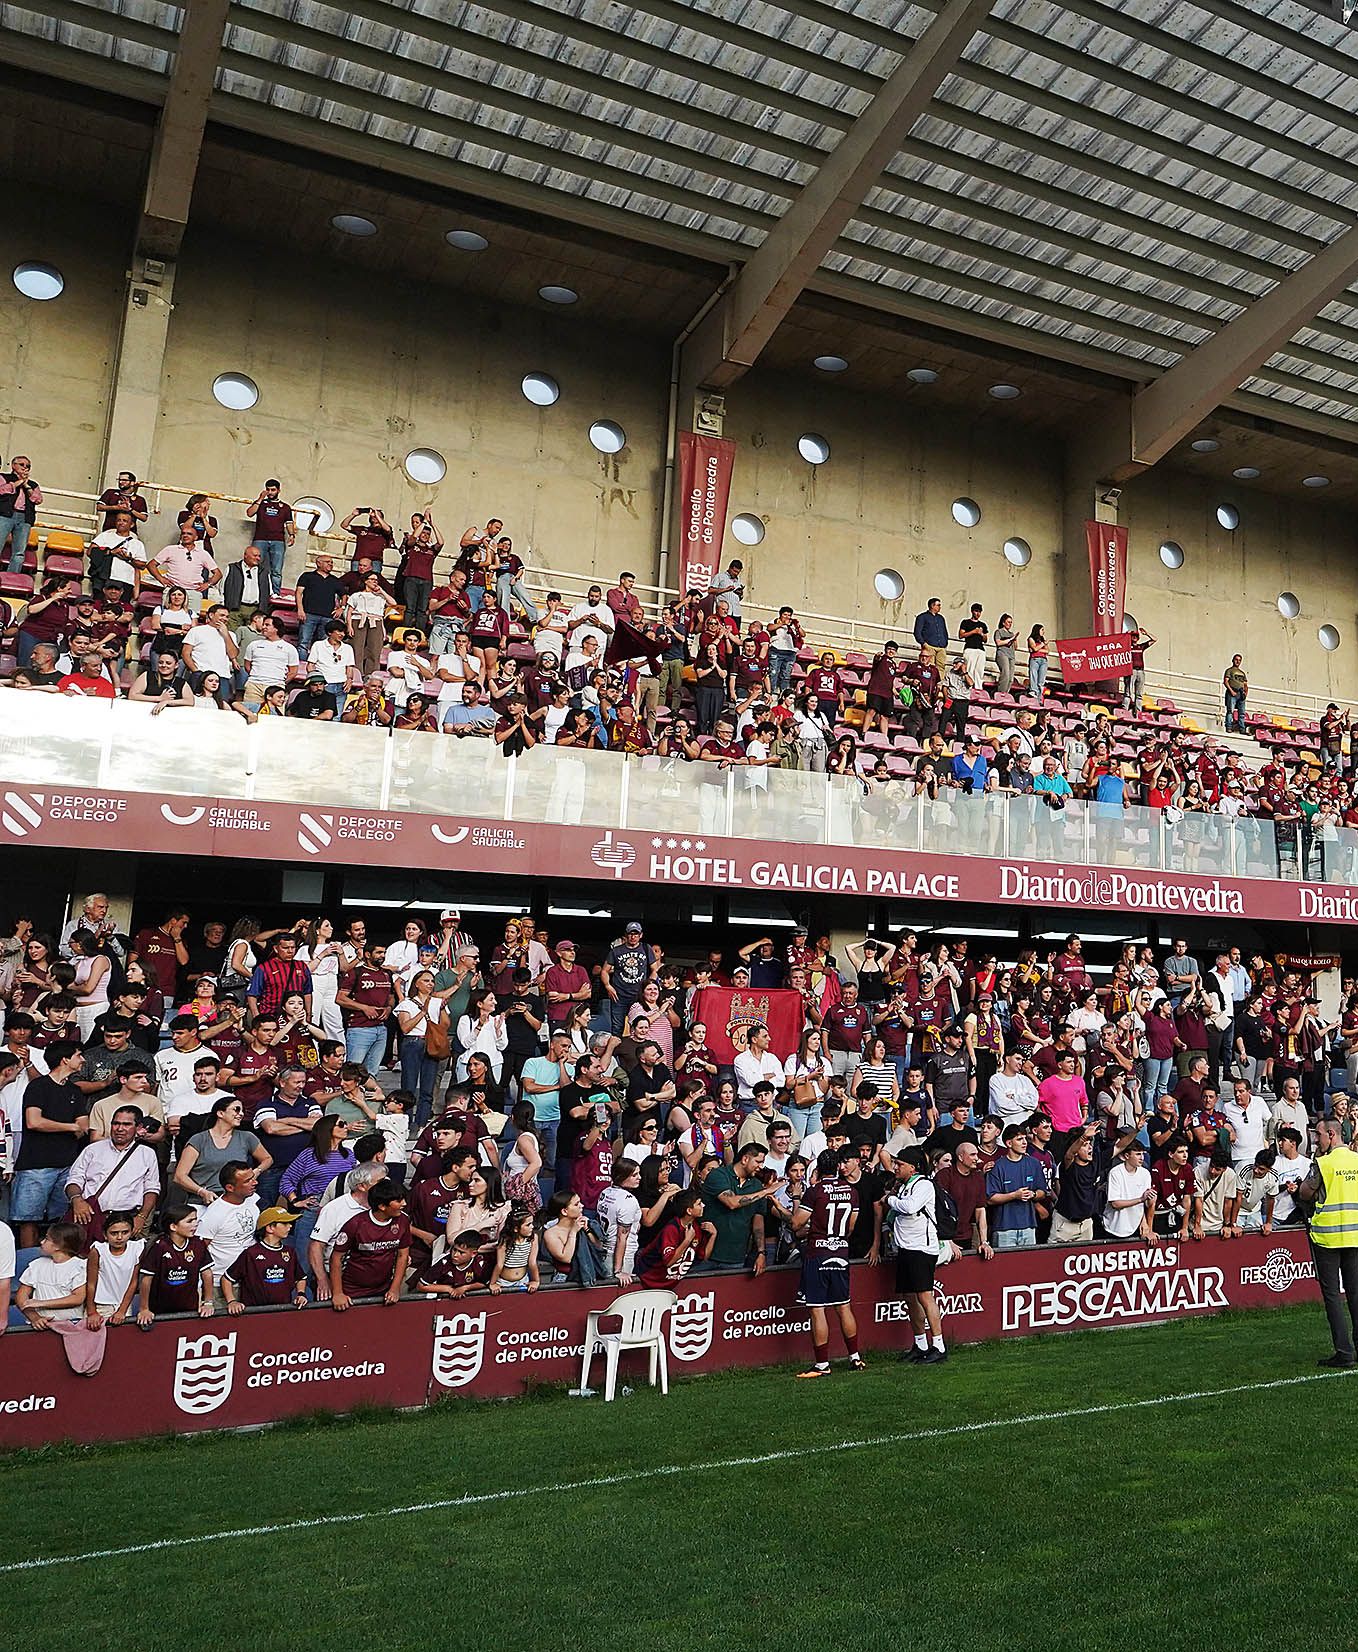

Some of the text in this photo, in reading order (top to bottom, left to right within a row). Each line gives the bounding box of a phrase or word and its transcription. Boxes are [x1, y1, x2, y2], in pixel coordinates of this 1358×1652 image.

[702, 456, 718, 544] de Pontevedra
[687, 488, 703, 542] Concello
[1107, 540, 1116, 602] Pontevedra
[1097, 569, 1106, 616] Concello
[1096, 642, 1123, 652] PEÑA
[51, 795, 127, 811] DEPORTE
[208, 806, 258, 821] GALICIA
[49, 807, 118, 822] GALEGO
[208, 816, 270, 832] SAUDABLE
[338, 816, 402, 831] DEPORTE
[337, 827, 396, 842] GALEGO
[471, 836, 525, 849] SAUDABLE
[472, 826, 514, 839] GALICIA
[650, 855, 959, 898] HOTEL GALICIA PALACE
[825, 1202, 852, 1237] 17
[1064, 1246, 1177, 1276] CONSERVAS
[875, 1293, 983, 1323] PESMAR
[1002, 1267, 1230, 1331] PESCAMAR
[723, 1305, 786, 1324] Concello
[496, 1327, 569, 1347] Concello
[722, 1317, 811, 1340] de Ponteved
[249, 1347, 333, 1369] Concello
[495, 1347, 517, 1364] de
[247, 1361, 386, 1389] de Pontevedra
